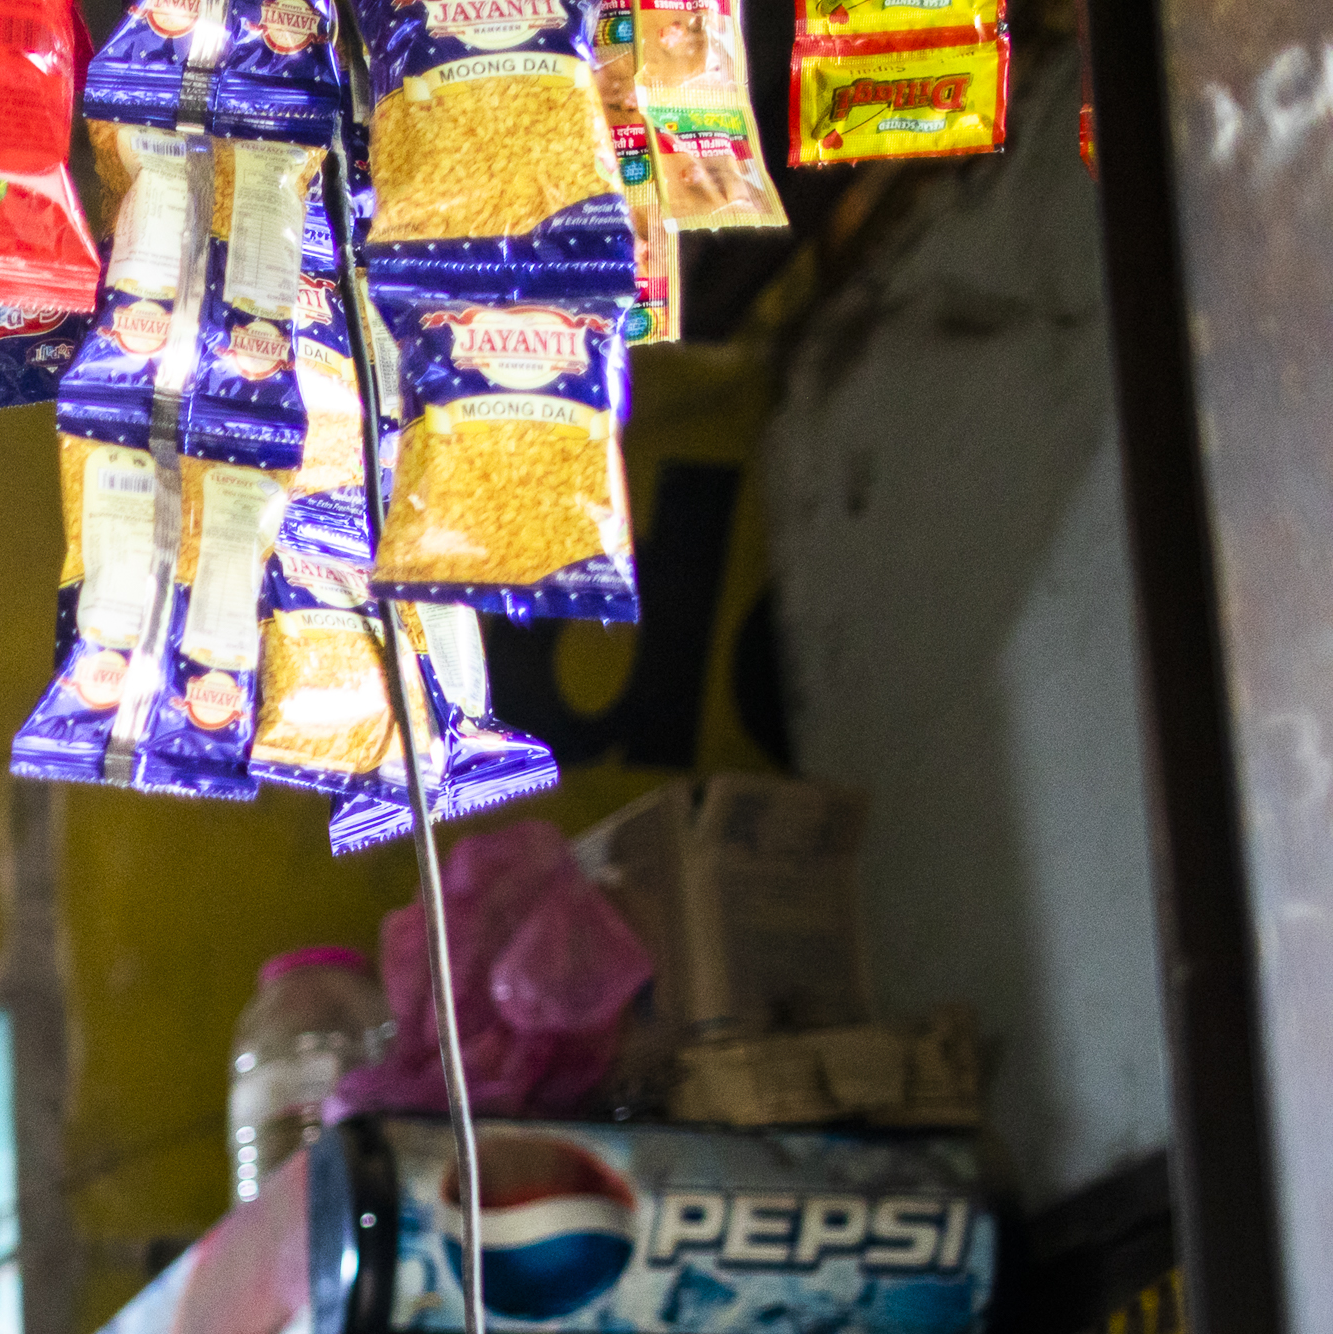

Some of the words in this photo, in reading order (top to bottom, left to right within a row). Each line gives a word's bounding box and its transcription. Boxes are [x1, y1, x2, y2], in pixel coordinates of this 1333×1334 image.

[263, 10, 317, 32] JAYANTI
[438, 60, 516, 84] MOONG
[523, 58, 563, 74] DAL
[878, 120, 916, 132] SCENTED
[918, 119, 945, 132] KESAR
[116, 317, 168, 337] JAYANTI
[232, 333, 285, 359] JAYANTI
[303, 343, 333, 364] DAL
[460, 327, 578, 357] JAYANTI
[462, 401, 535, 418] MOONG
[541, 404, 579, 425] DAL
[301, 613, 358, 630] MOONG
[362, 620, 383, 635] DA
[189, 686, 241, 710] JAYANTI
[651, 1195, 970, 1268] PEPSI
